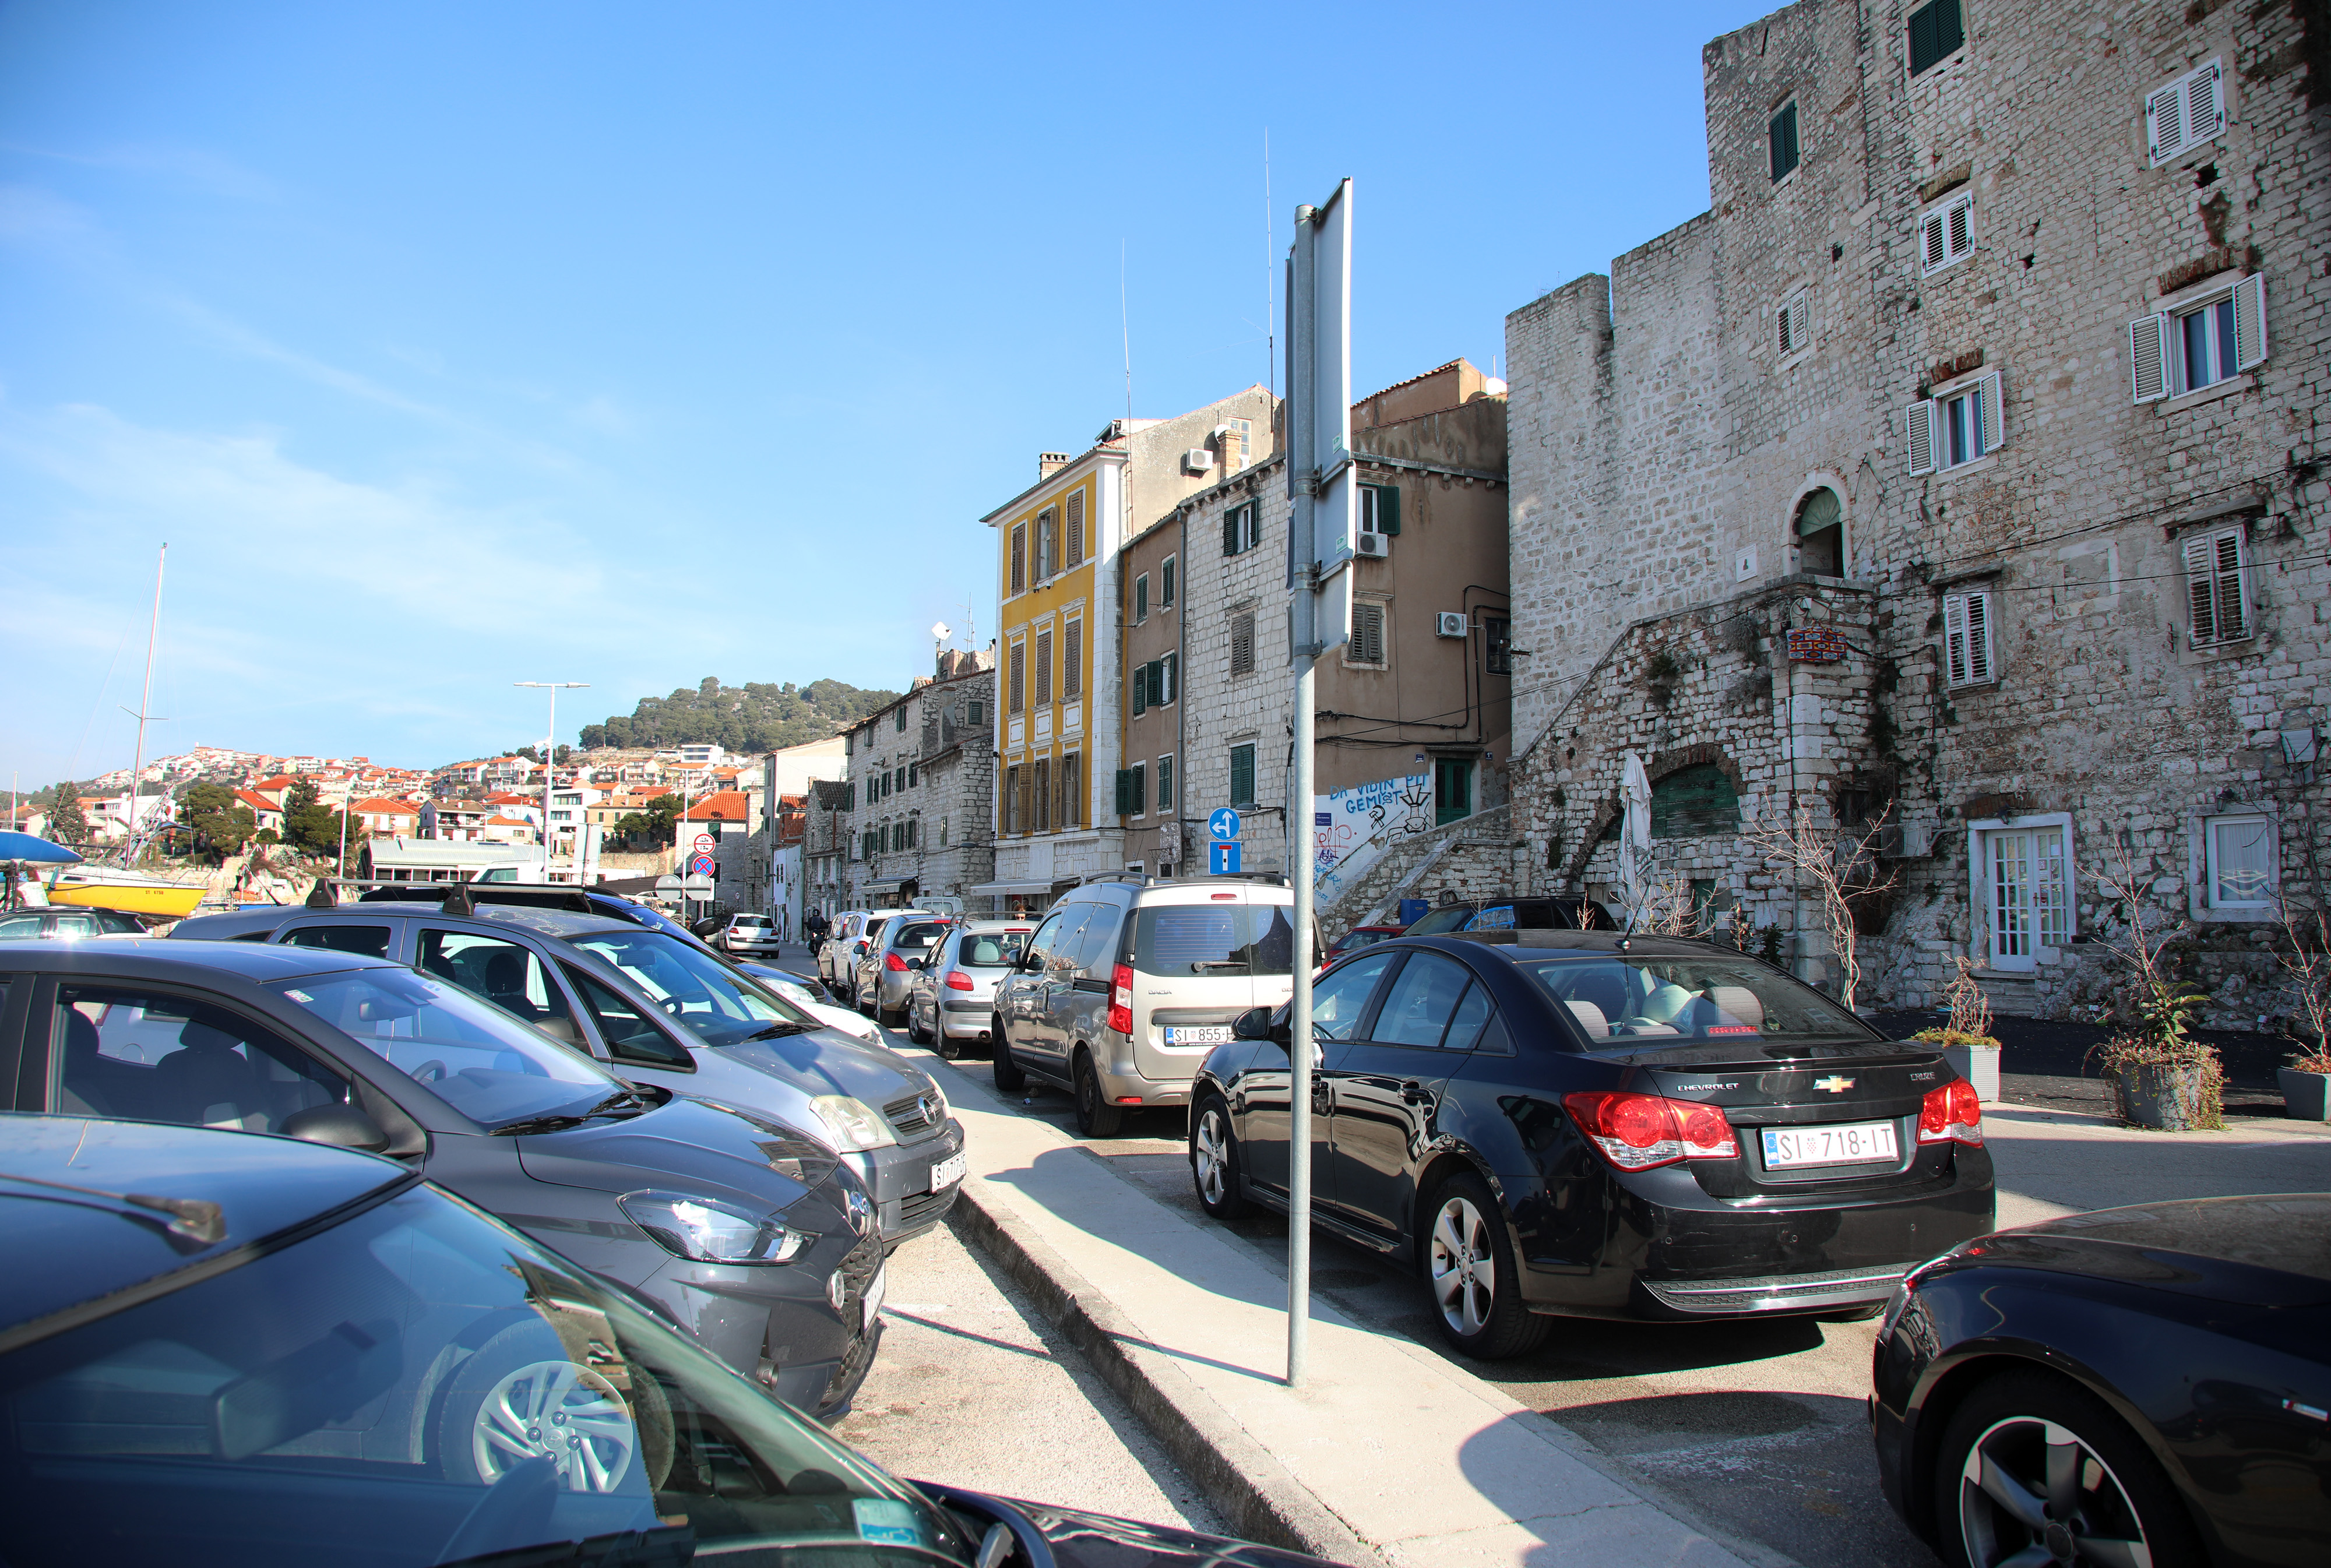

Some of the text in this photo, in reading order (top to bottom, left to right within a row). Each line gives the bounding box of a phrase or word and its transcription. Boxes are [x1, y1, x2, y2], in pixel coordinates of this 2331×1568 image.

[1330, 785, 1347, 801] DA
[1355, 778, 1394, 795] VIDIN
[1346, 790, 1403, 814] GEMIŠT
[1175, 1029, 1186, 1042] ŠI
[1910, 1072, 1935, 1081] CRUZE
[1677, 1083, 1740, 1091] CHEVROLET
[1768, 1128, 1890, 1160] HR ŠI 718-IT
